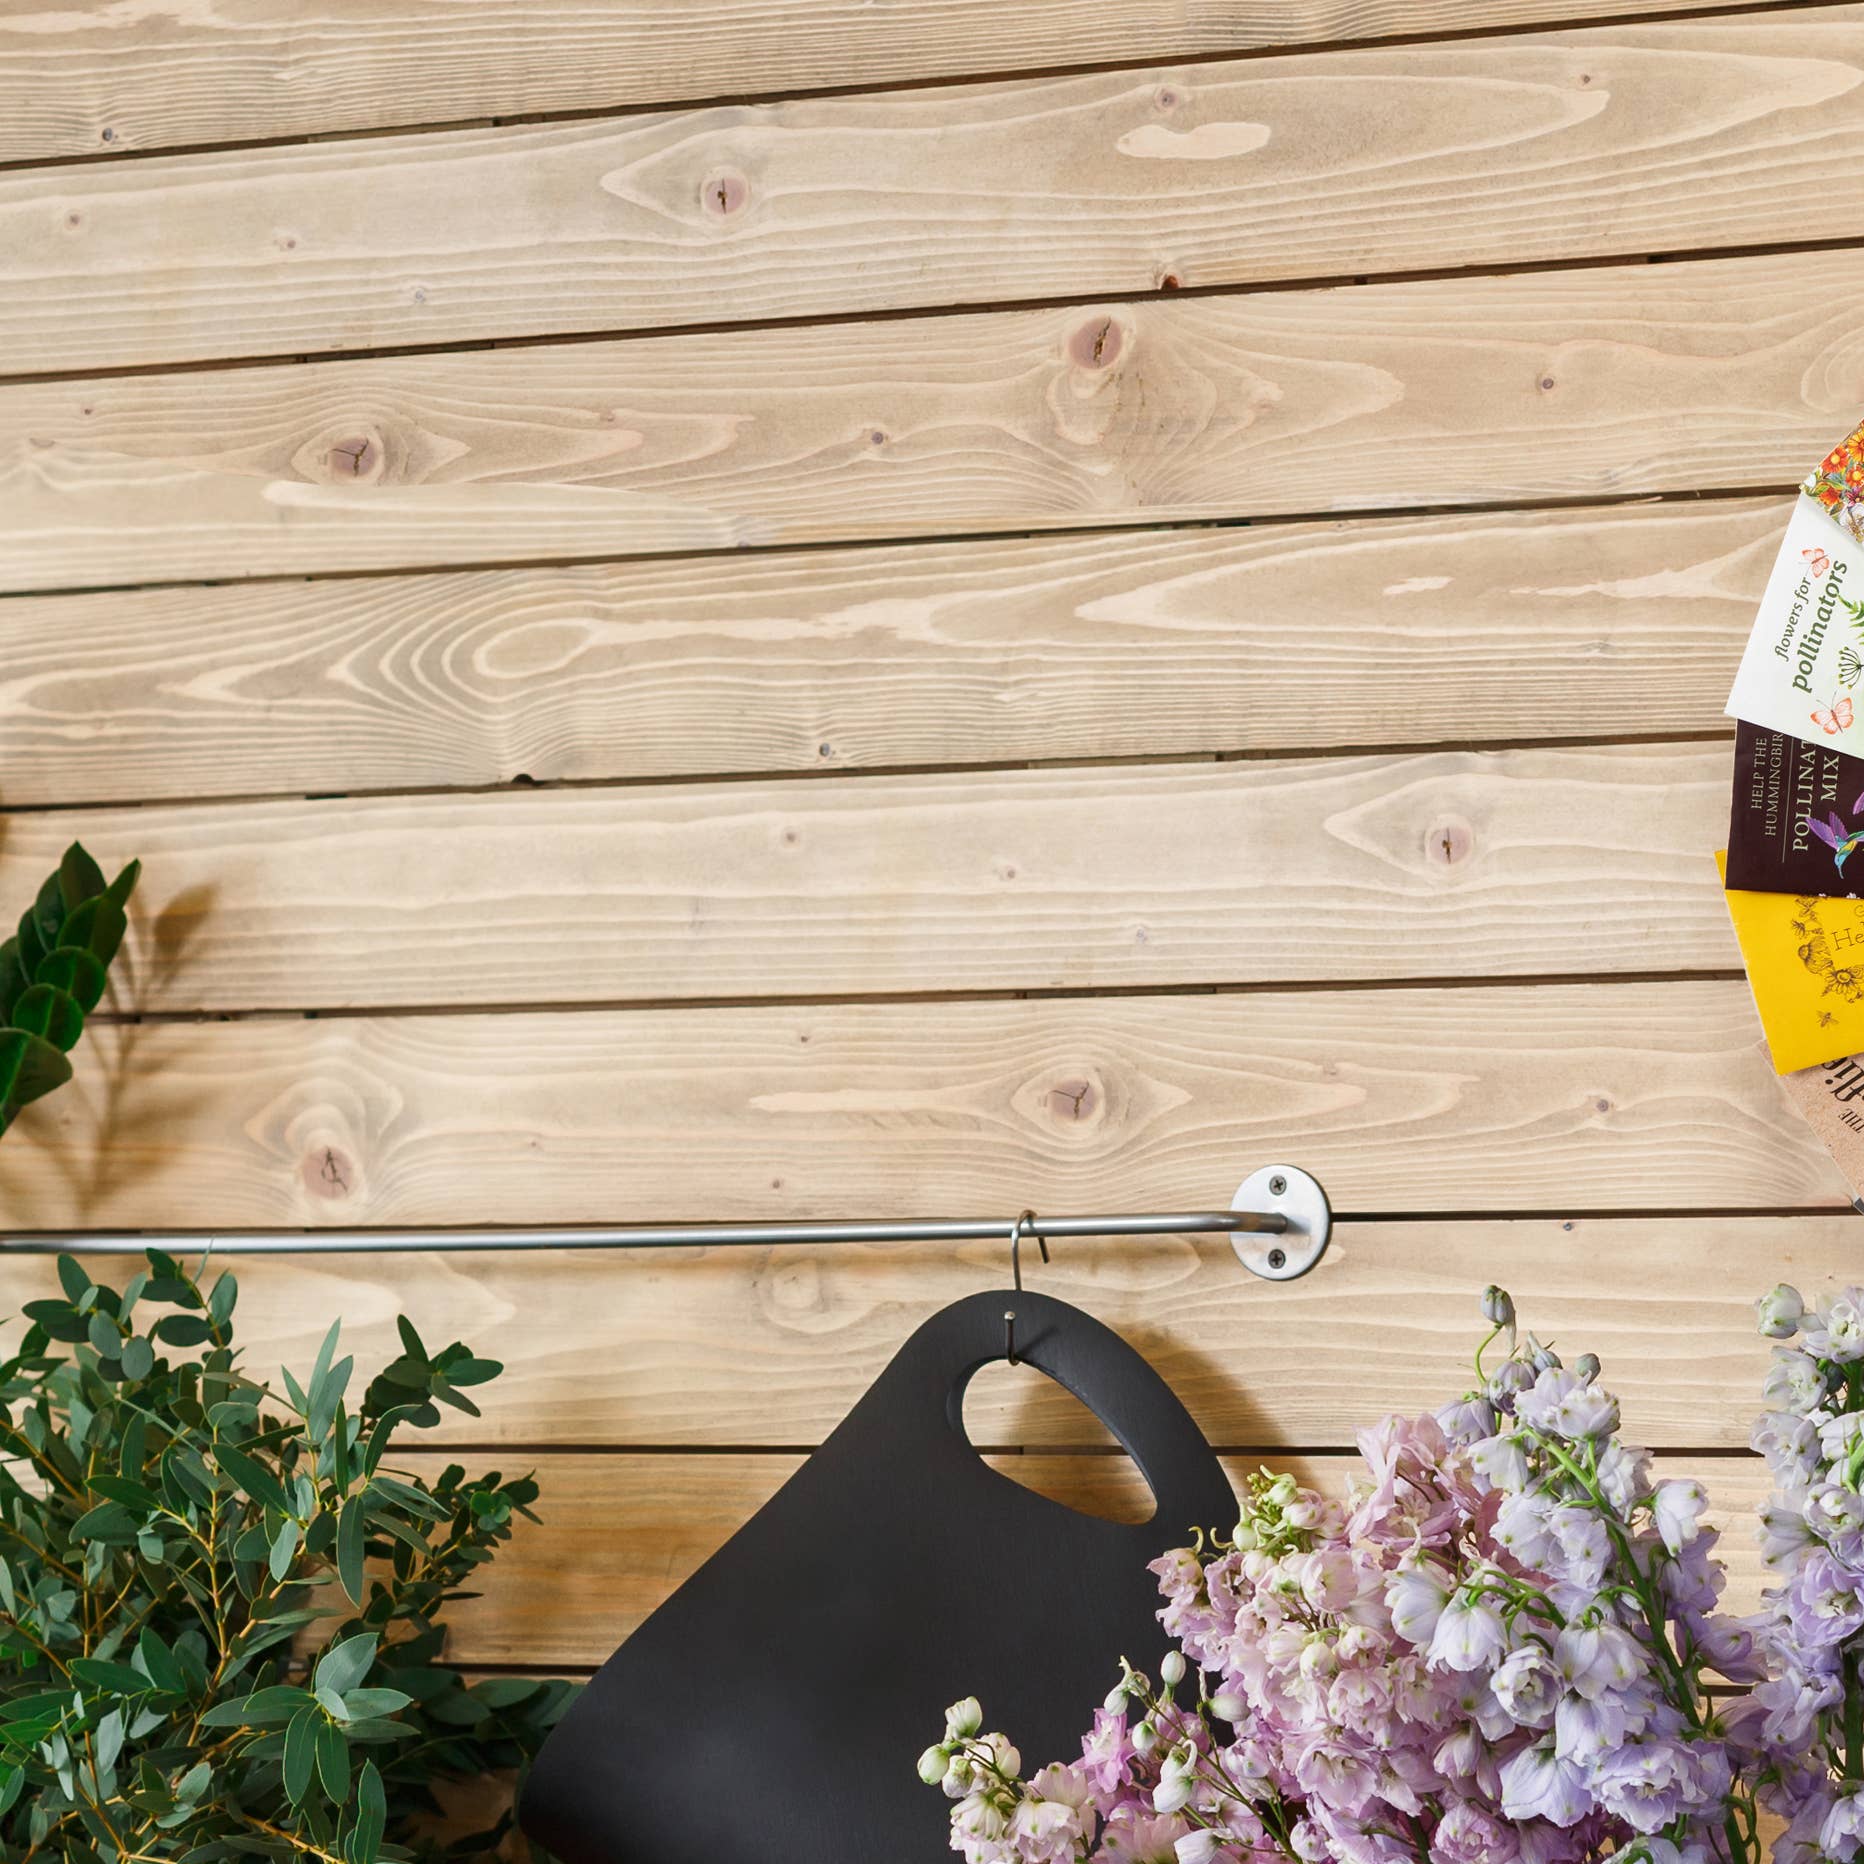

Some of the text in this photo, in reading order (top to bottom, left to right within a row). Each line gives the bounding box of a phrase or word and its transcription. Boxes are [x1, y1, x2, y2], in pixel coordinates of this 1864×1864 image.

[1774, 576, 1812, 662] flowers for
[1792, 560, 1848, 694] pollinators
[1751, 737, 1767, 809] HELP THE
[1820, 755, 1840, 801] MIX
